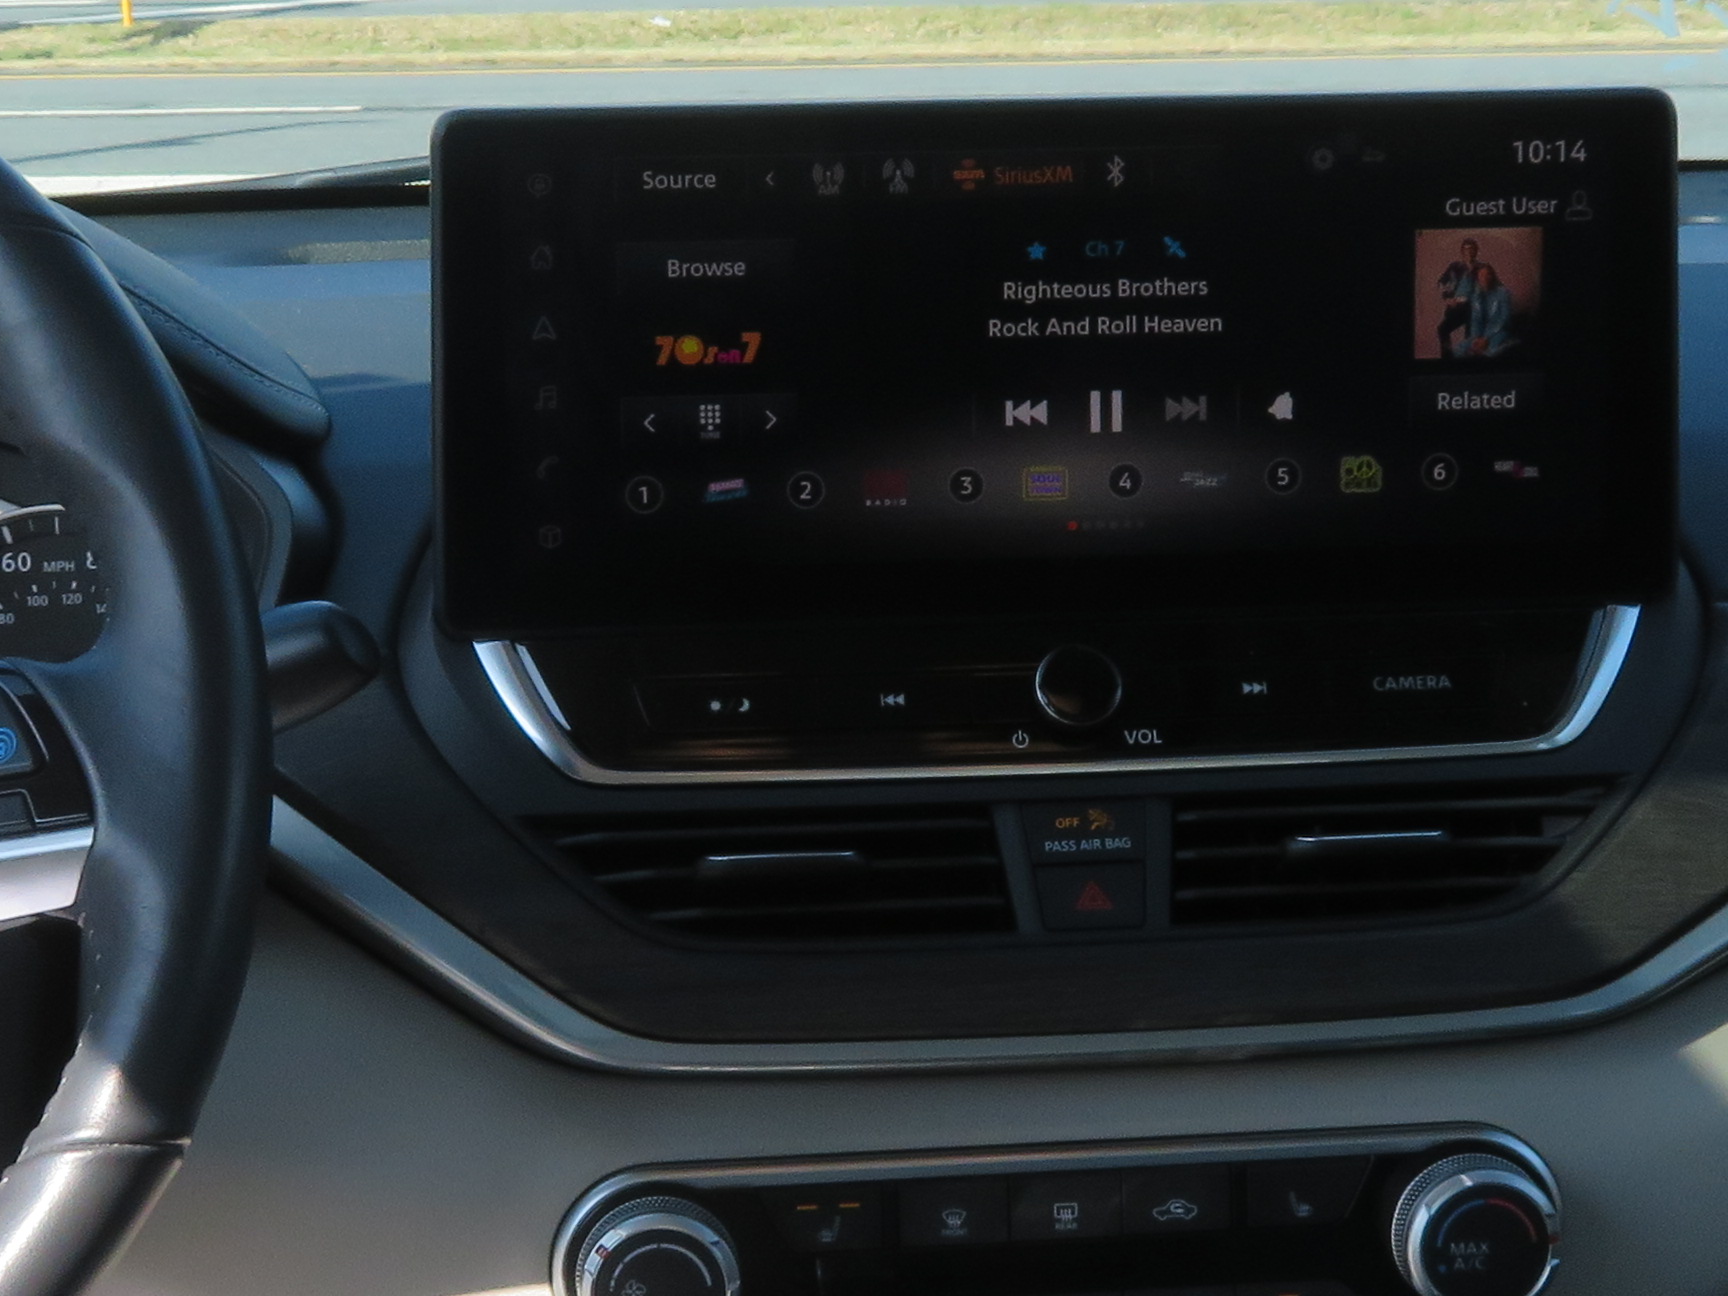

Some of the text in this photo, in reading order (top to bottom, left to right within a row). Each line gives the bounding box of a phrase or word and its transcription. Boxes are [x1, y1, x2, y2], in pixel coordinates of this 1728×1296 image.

[1513, 139, 1588, 164] 10:14
[642, 170, 717, 190] Source
[993, 165, 1073, 185] SiriusXM
[1445, 196, 1558, 216] Guest User
[1084, 239, 1125, 257] Ch 7
[666, 259, 746, 277] Browse
[1003, 276, 1209, 304] Righteous Brothers
[987, 313, 1223, 338] Rock And Roll Heaven
[1437, 388, 1516, 411] Related
[1118, 471, 1133, 490] 4
[1276, 467, 1290, 486] 5
[1432, 463, 1446, 481] 6
[798, 481, 813, 500] 2
[958, 476, 973, 494] 3
[638, 486, 649, 504] 1
[1, 551, 32, 573] 60
[43, 560, 75, 573] MPH
[26, 595, 50, 607] 100
[61, 593, 83, 605] 120
[1373, 673, 1453, 692] CAMERA
[1125, 728, 1163, 745] VOL
[1055, 816, 1080, 830] OFF
[1044, 836, 1132, 853] PASS AIR BAG
[1449, 1240, 1491, 1256] MAX
[1453, 1256, 1488, 1271] A/C
